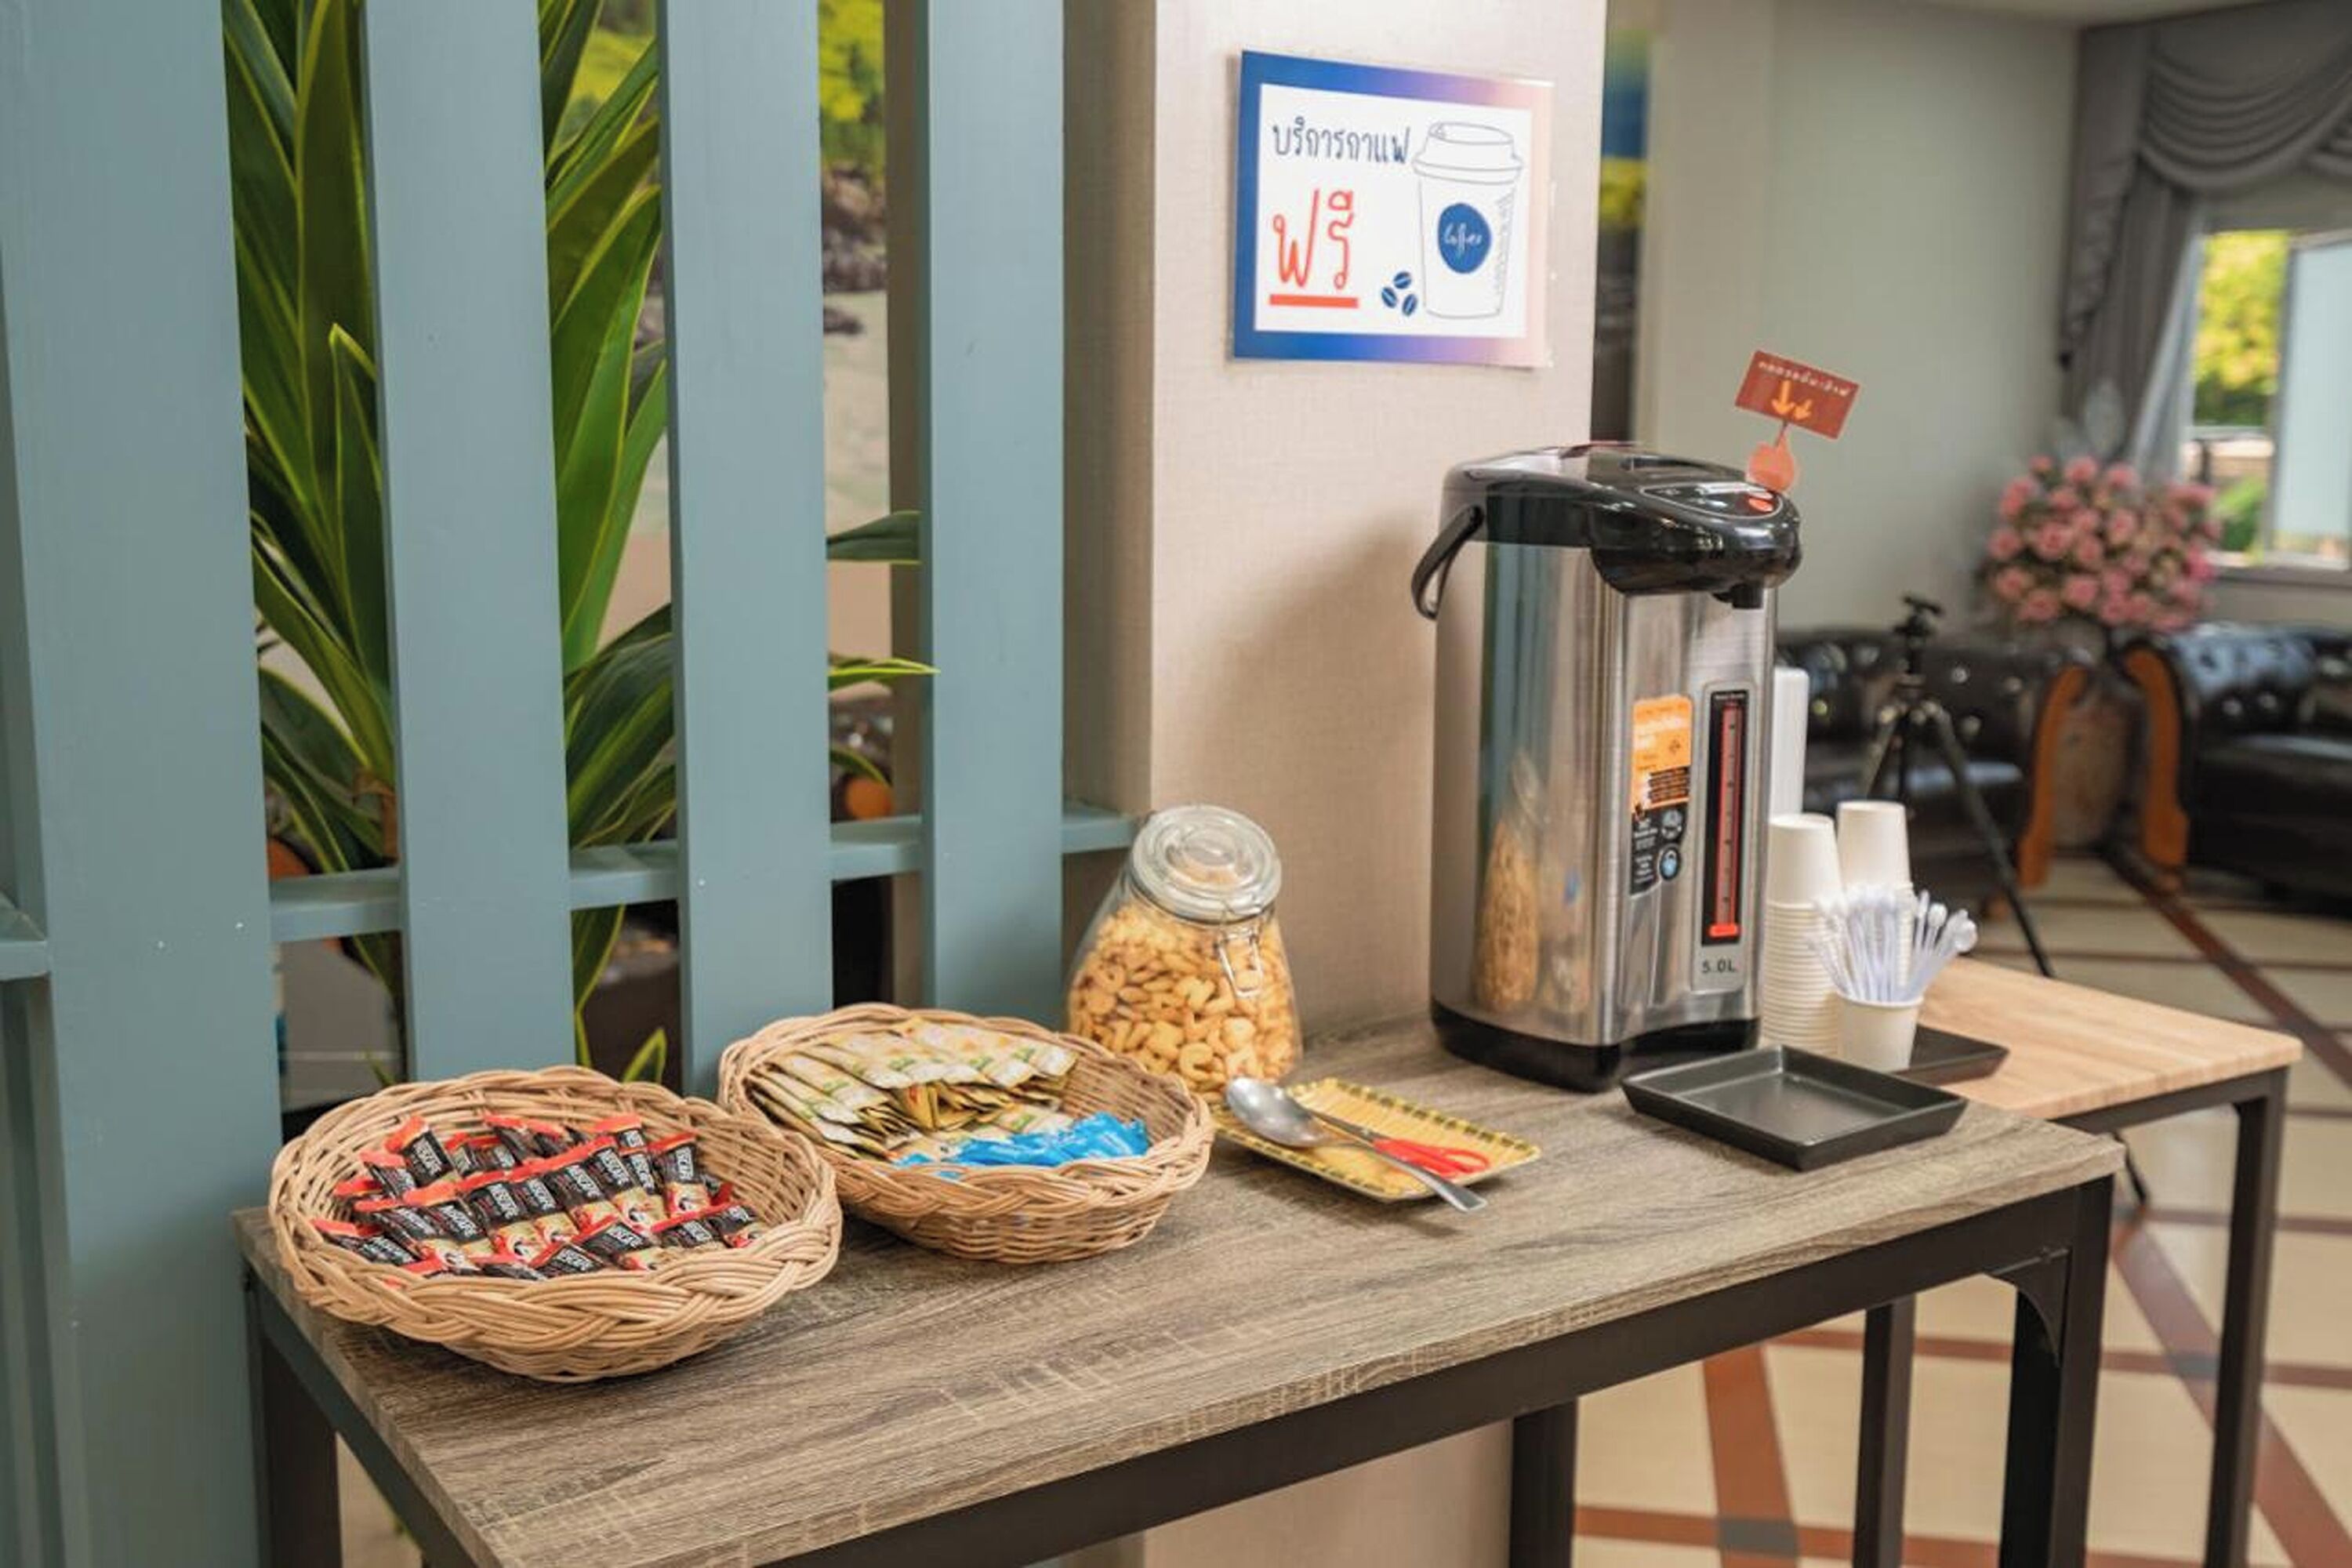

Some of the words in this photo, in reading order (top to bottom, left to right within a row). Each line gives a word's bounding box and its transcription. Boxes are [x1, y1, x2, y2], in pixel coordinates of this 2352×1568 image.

[1272, 116, 1411, 165] บริการกาแฟ
[1272, 189, 1354, 289] ฟรี
[1701, 959, 1737, 974] 5.0L
